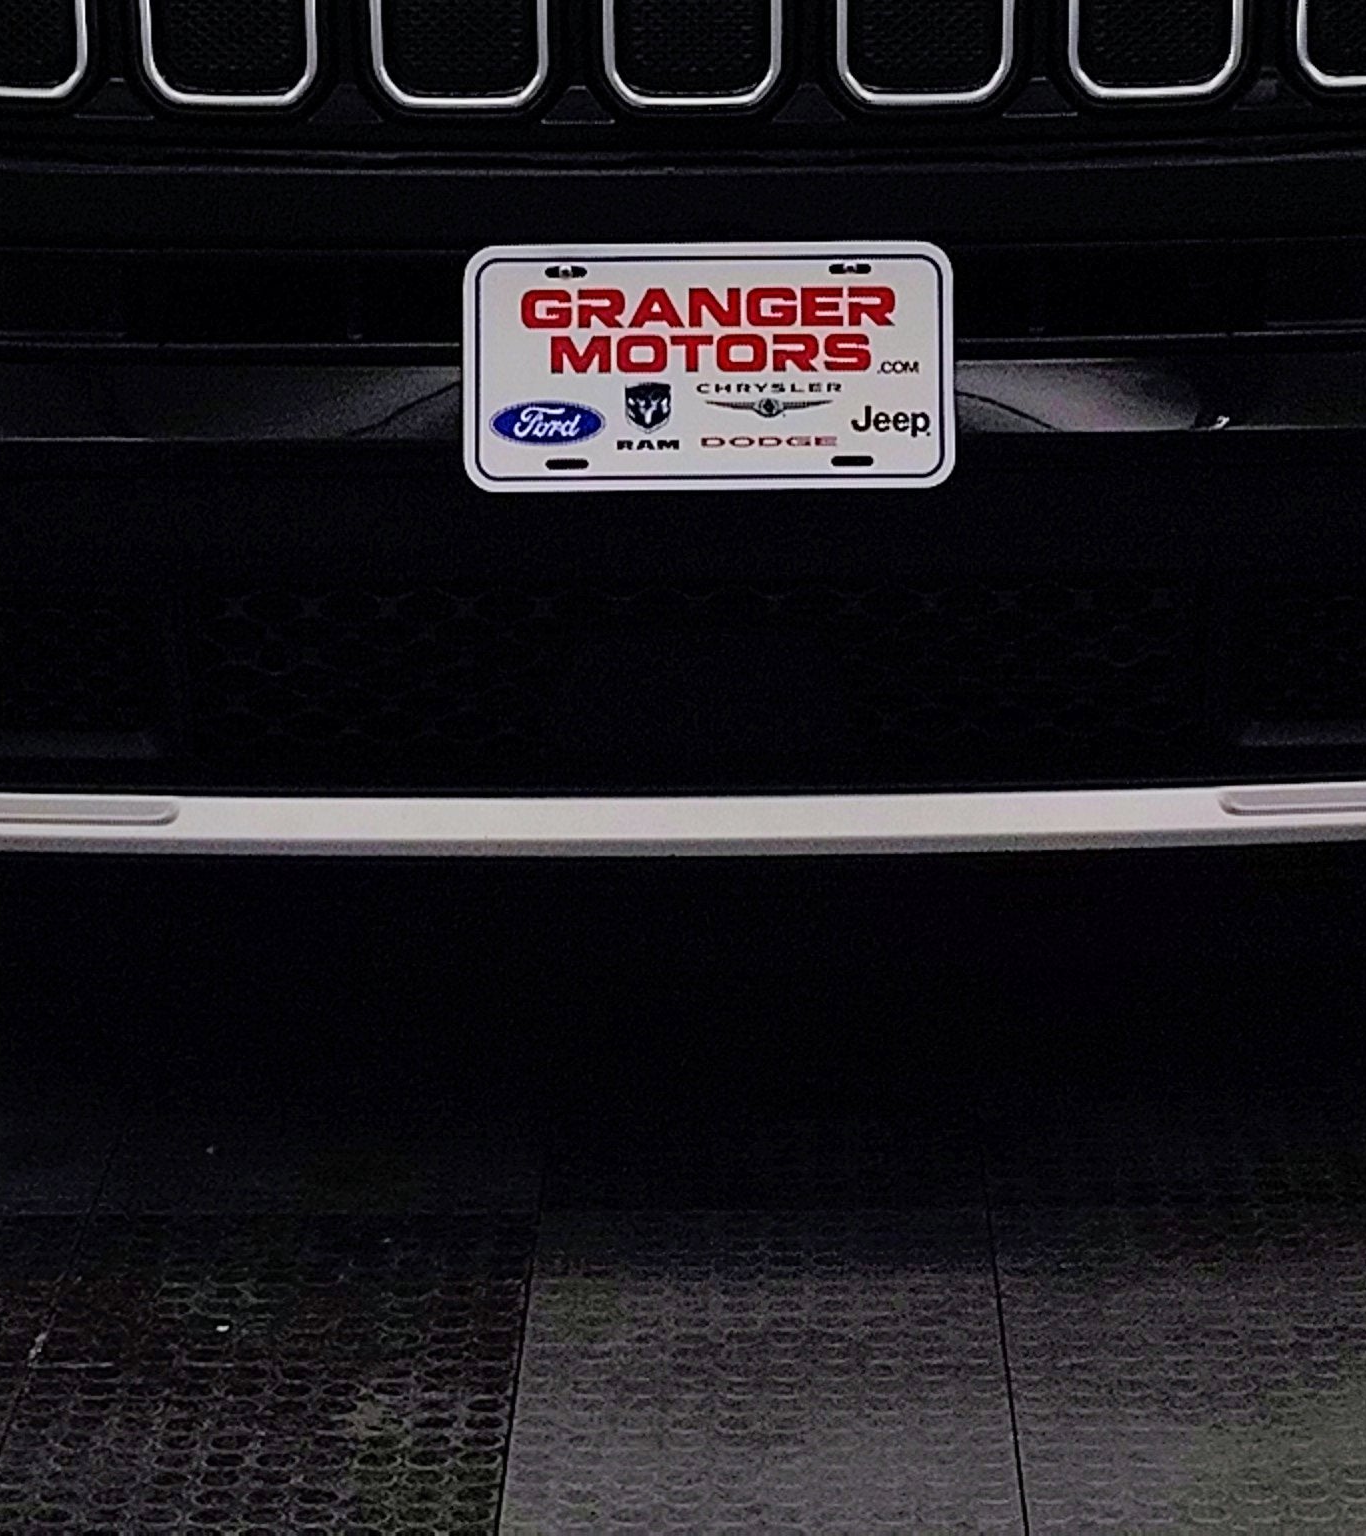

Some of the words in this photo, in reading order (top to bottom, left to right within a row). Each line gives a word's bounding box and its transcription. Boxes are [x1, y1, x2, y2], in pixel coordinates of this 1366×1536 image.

[520, 287, 896, 329] GRANGER
[550, 333, 872, 374] MOTORS
[877, 361, 920, 374] .COM
[696, 382, 842, 394] CHRYSLER
[512, 406, 580, 438] Ford
[851, 406, 931, 438] Jeep
[616, 439, 680, 451] RAM
[700, 436, 838, 448] DODGE
